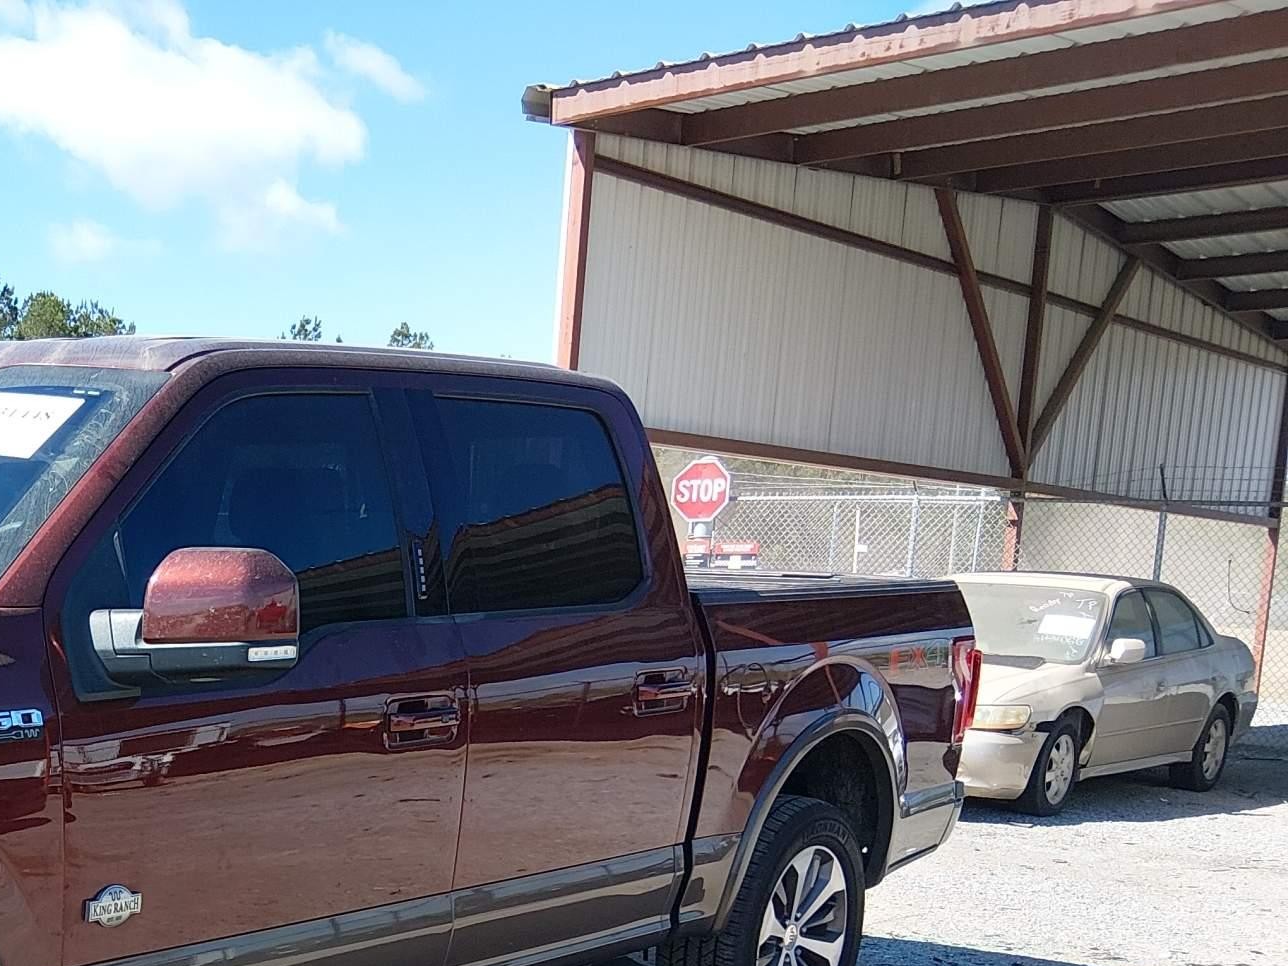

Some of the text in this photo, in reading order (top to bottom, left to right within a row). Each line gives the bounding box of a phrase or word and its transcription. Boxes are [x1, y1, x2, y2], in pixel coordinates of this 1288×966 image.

[676, 478, 726, 503] STOP
[889, 640, 945, 673] FX4
[93, 897, 139, 917] KING RANCH
